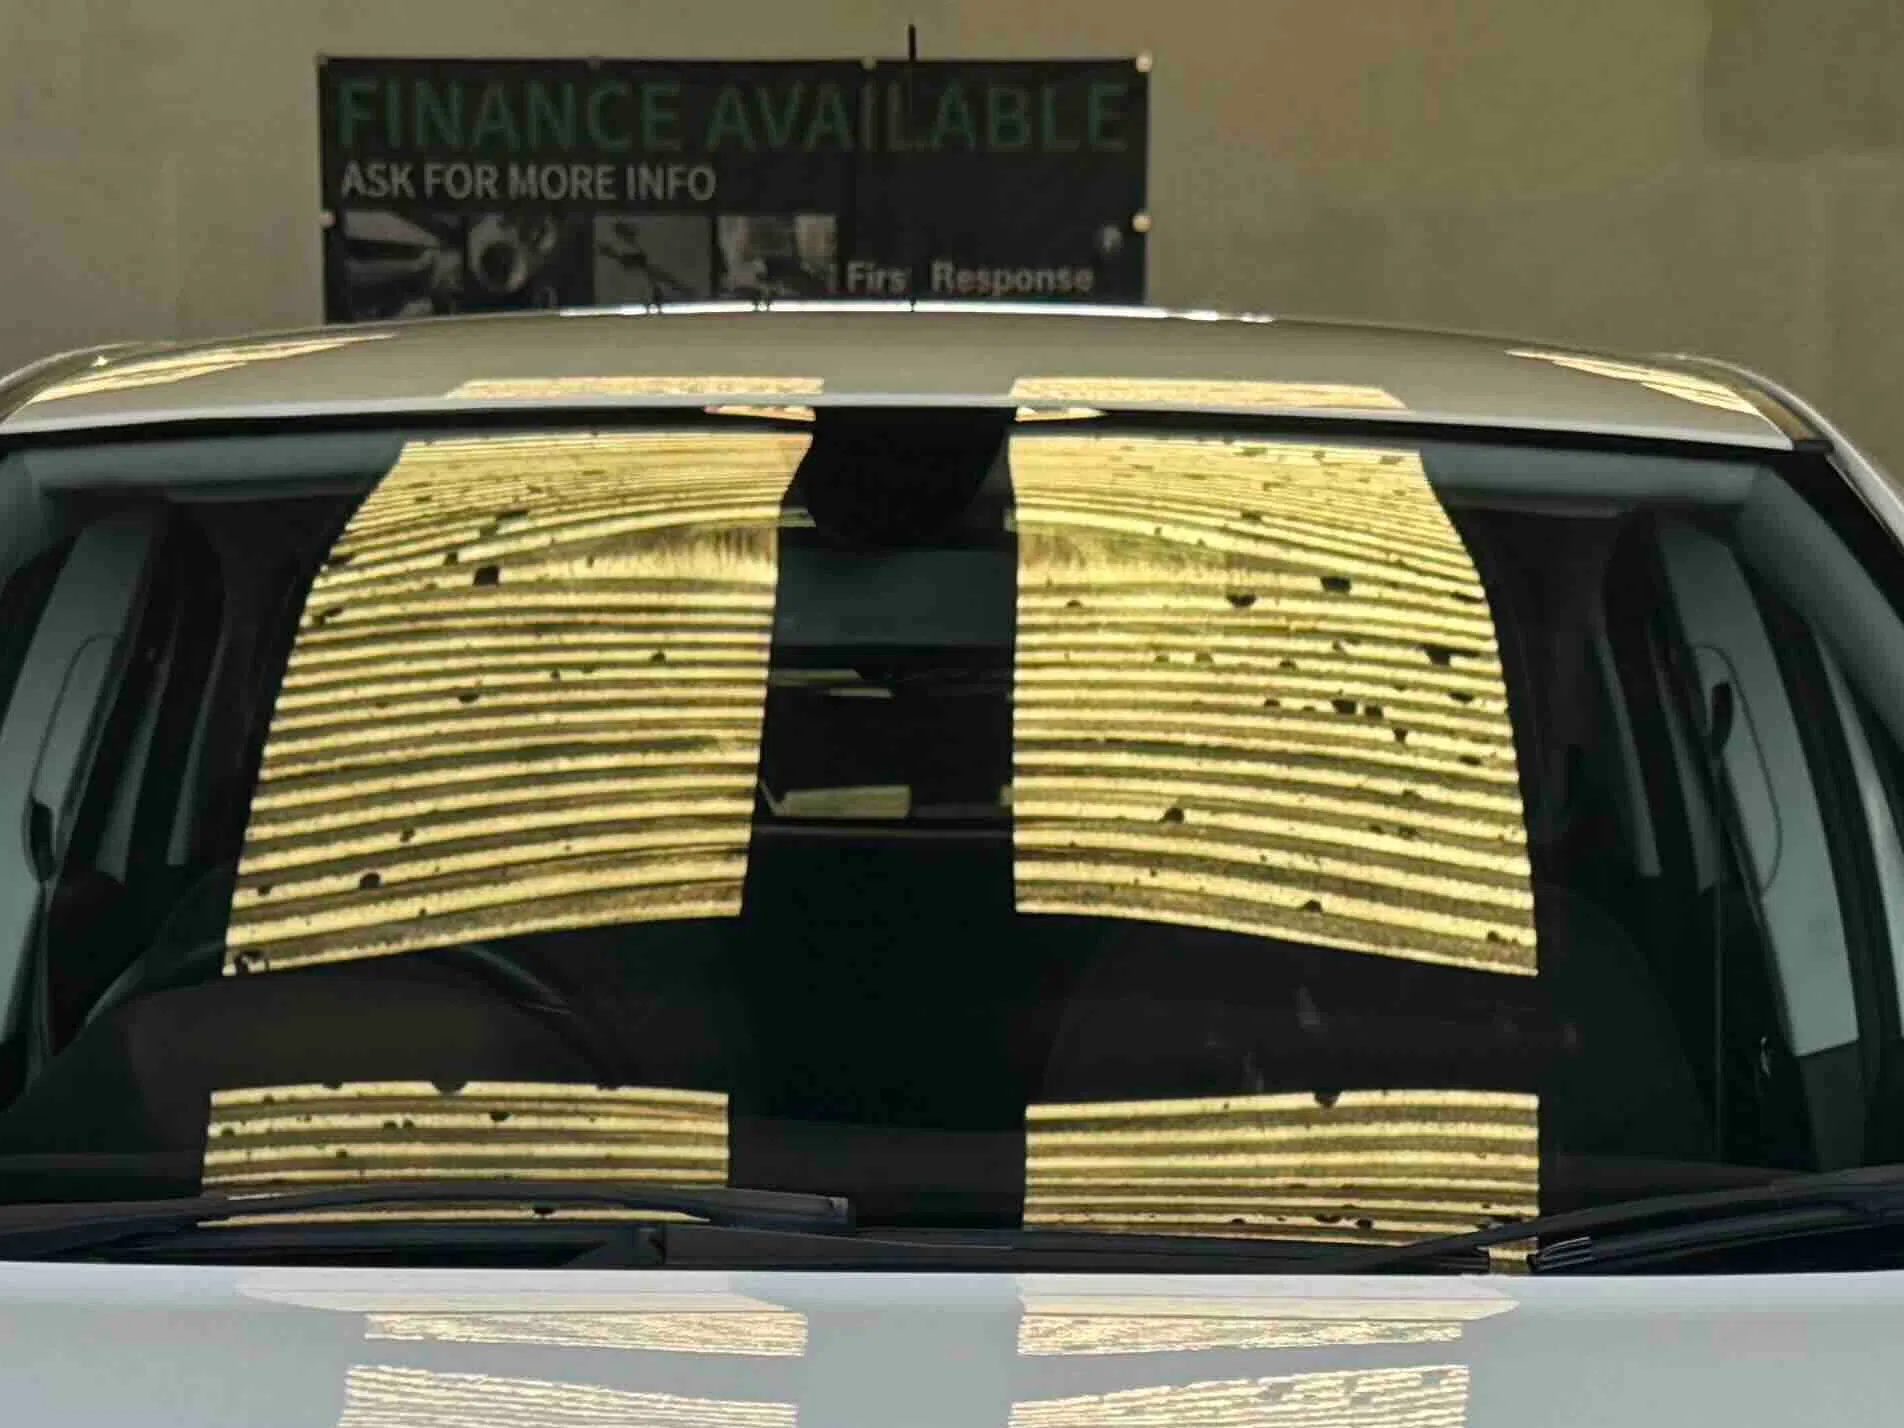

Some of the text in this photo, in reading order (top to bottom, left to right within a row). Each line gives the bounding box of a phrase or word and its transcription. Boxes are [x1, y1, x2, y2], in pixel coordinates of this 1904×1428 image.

[337, 80, 1129, 152] FINANCE AVAILABLE
[340, 160, 718, 201] ASK FOR MORE INFO
[846, 258, 1096, 297] Firs Response
